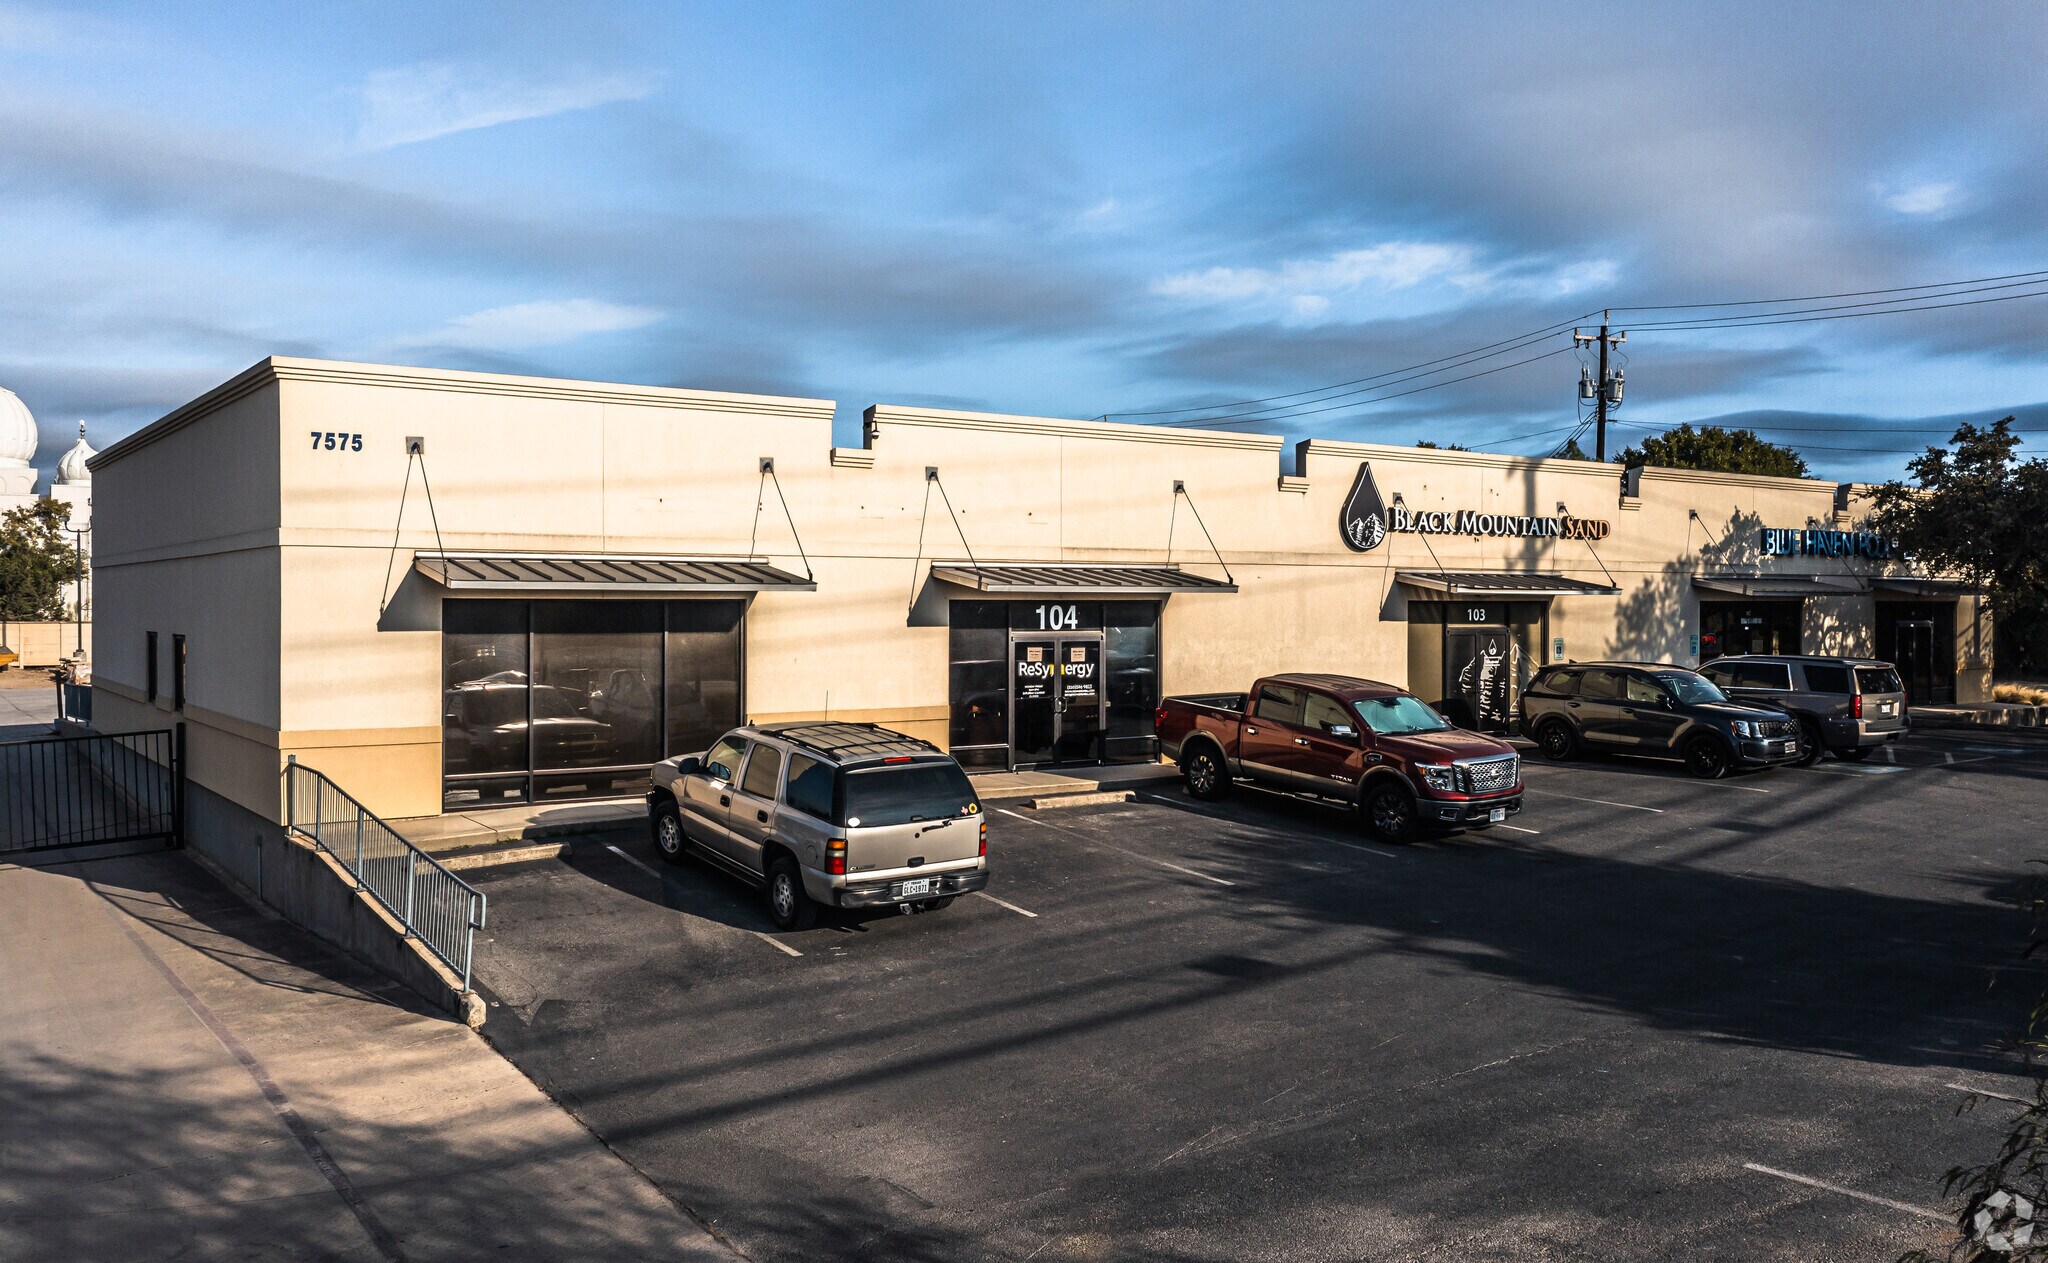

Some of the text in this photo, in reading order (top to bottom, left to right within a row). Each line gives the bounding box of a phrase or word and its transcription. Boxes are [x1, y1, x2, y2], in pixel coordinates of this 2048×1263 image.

[311, 431, 363, 452] 7575
[1393, 507, 1611, 539] BLACK MOUNTAIN SAND
[1765, 528, 1801, 555] BLUE
[1806, 529, 1855, 556] HAVEN
[1035, 605, 1079, 631] 104
[1467, 608, 1486, 621] 103
